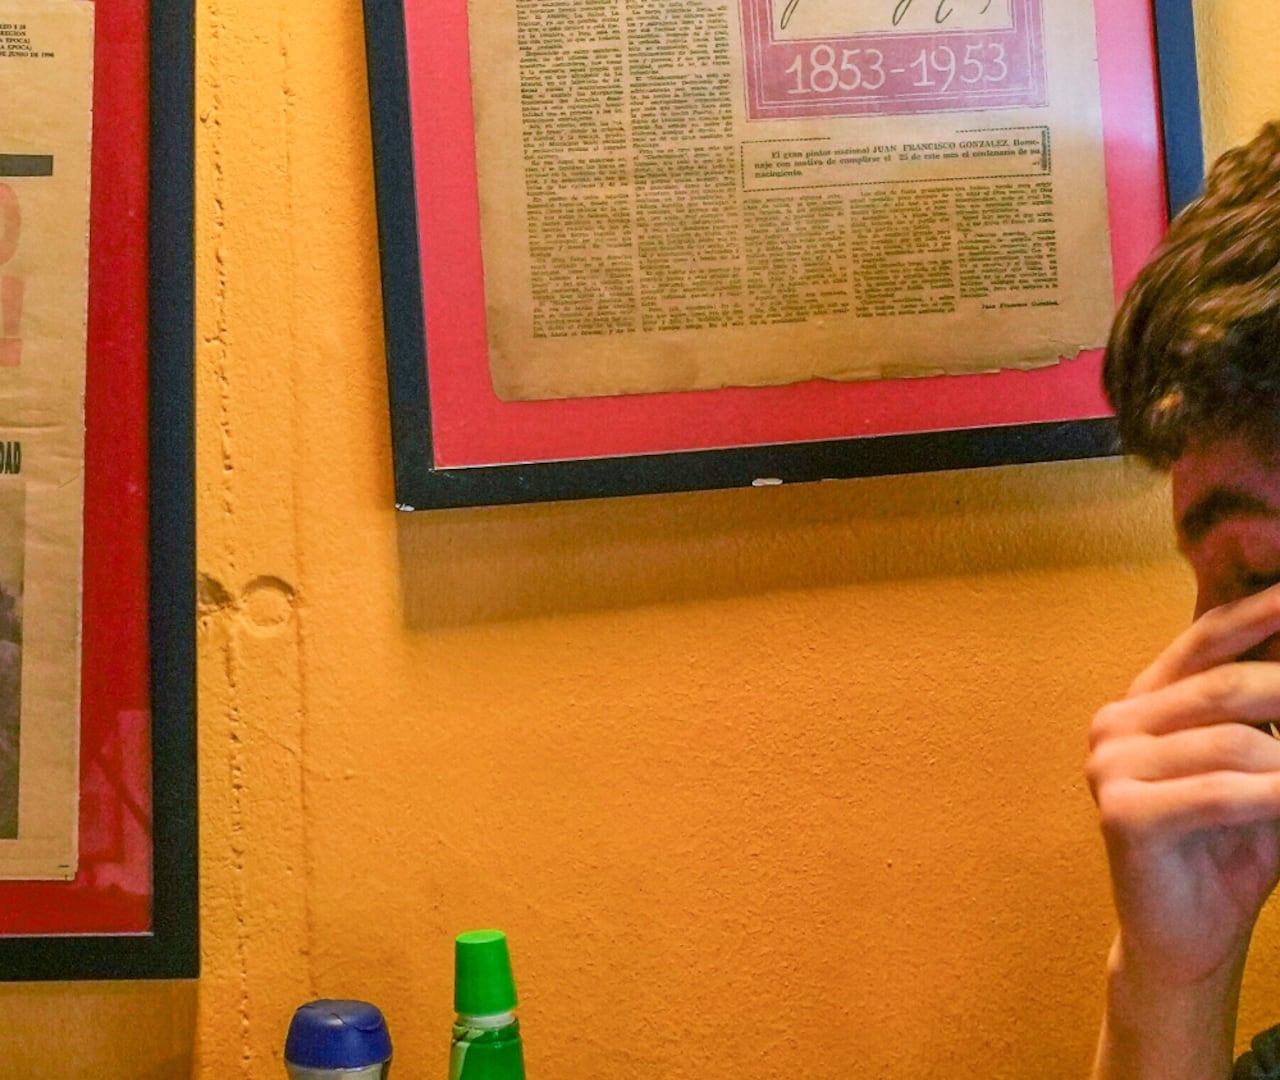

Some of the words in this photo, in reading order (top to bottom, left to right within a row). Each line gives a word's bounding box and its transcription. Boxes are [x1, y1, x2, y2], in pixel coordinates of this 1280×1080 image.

[785, 43, 1009, 95] 1853-1953
[873, 145, 897, 153] JUAN
[903, 142, 956, 152] FRANCISCO
